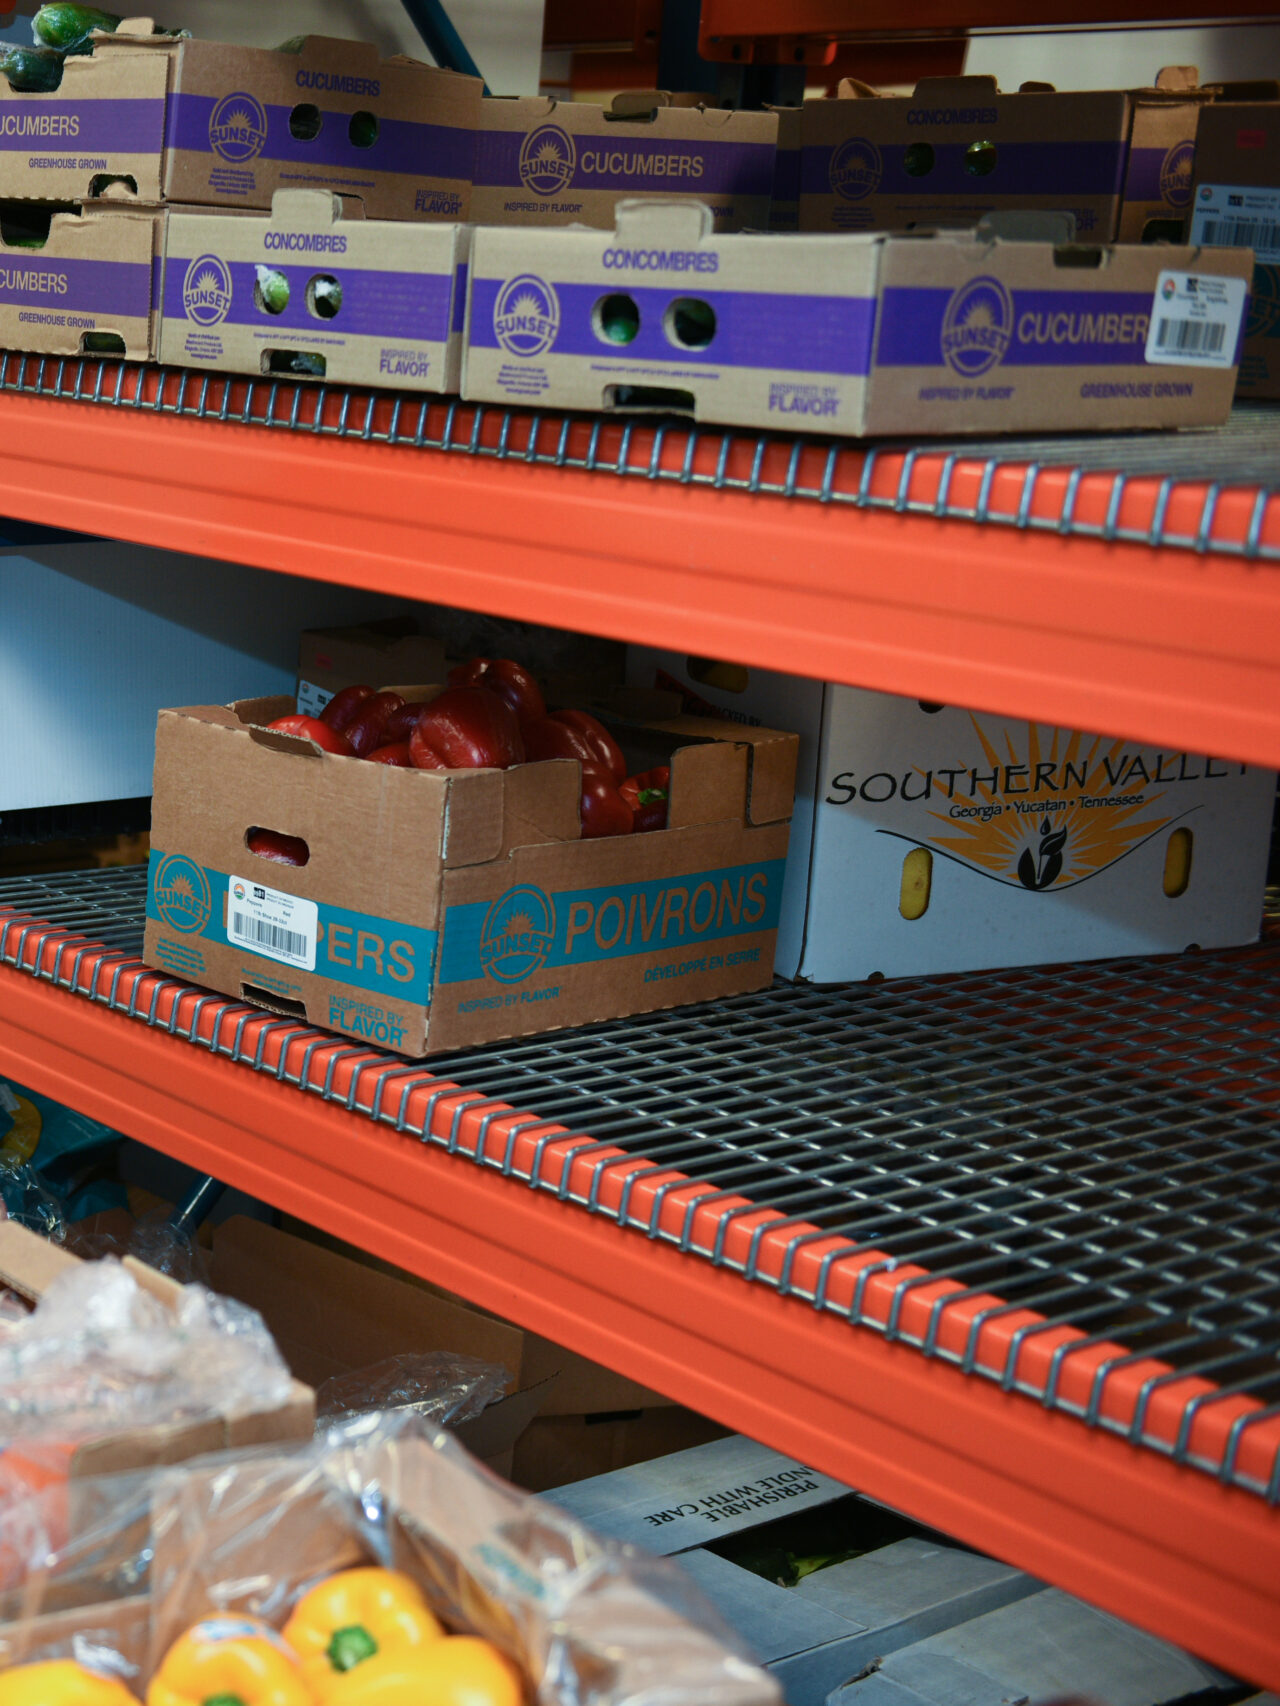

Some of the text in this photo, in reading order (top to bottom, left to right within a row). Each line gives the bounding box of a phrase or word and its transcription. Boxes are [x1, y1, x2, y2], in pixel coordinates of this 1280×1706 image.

[296, 70, 381, 97] CUCUMBERS
[907, 107, 998, 125] CONCOMBRES
[210, 126, 265, 149] SUNSET
[29, 158, 107, 170] GREENHOUSE GROWN
[521, 160, 575, 178] SUNSET
[580, 151, 704, 177] CUCUMBERS
[416, 189, 460, 201] INSPIRED BY
[504, 202, 538, 213] INSPIRED
[540, 203, 550, 213] BY
[264, 231, 348, 253] CONCOMBRES
[601, 249, 720, 273] CONCOMBRES
[184, 289, 230, 308] SUNSET
[18, 311, 95, 329] GREENHOUSE GROWN
[495, 315, 558, 339] SUNSET
[1018, 313, 1149, 344] CUCUMBER
[942, 325, 1010, 349] SUNSET
[380, 348, 428, 362] INSPIRED BY
[1080, 382, 1193, 399] GREENHOUSE GROWN
[825, 760, 1089, 805] SOUTHERN
[949, 793, 1145, 821] Georgia Yucatan Tennessee
[155, 889, 210, 922] SUNSET
[565, 872, 768, 954] POIVRONS
[481, 932, 553, 965] SUNSET
[644, 948, 760, 982] DÉVELOPPÉ EN SERRE
[329, 995, 403, 1026] INSPIRED BY
[458, 995, 503, 1013] INSPIRED
[505, 993, 519, 1010] BY
[643, 1466, 822, 1527] NDLE WITH CARE
[701, 1479, 820, 1522] PERISHABLE
